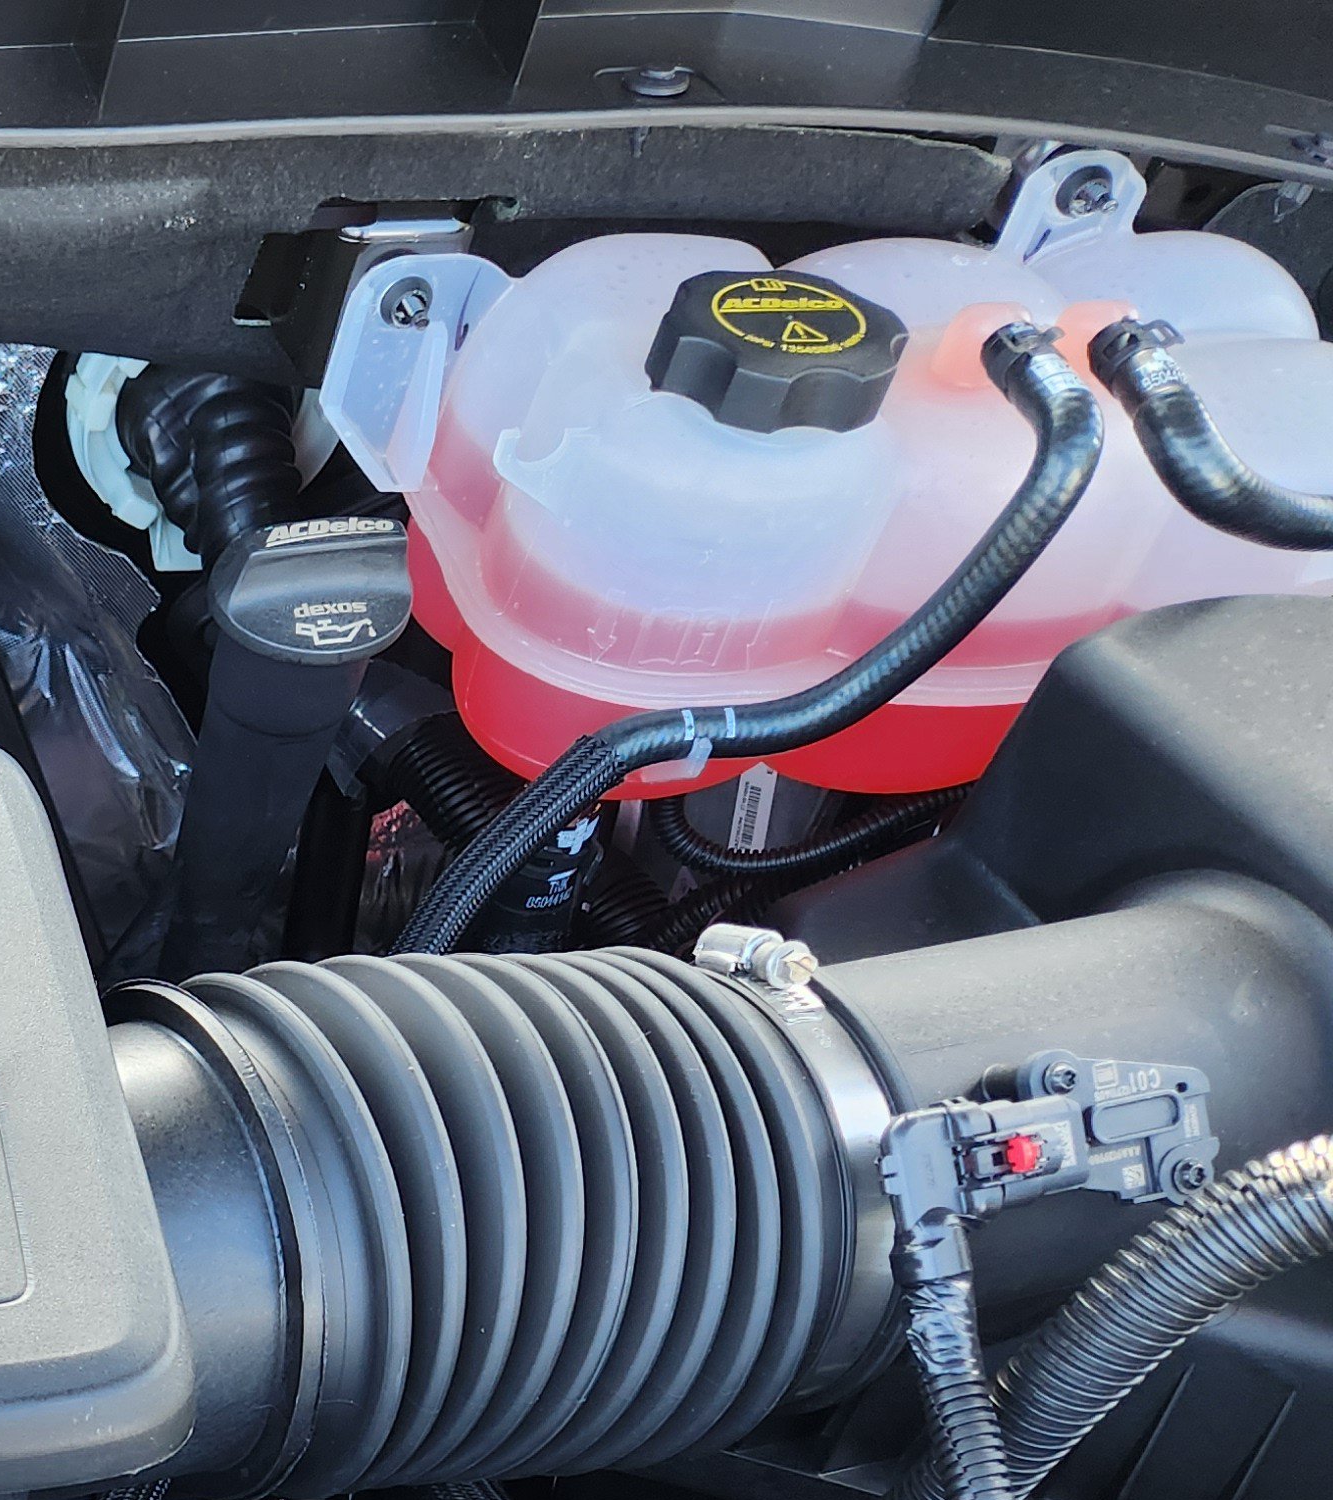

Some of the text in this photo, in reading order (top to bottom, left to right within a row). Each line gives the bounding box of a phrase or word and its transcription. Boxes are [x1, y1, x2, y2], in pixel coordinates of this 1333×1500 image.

[720, 297, 846, 311] ACDelco
[265, 516, 395, 544] ACDelco
[293, 602, 368, 618] dexos
